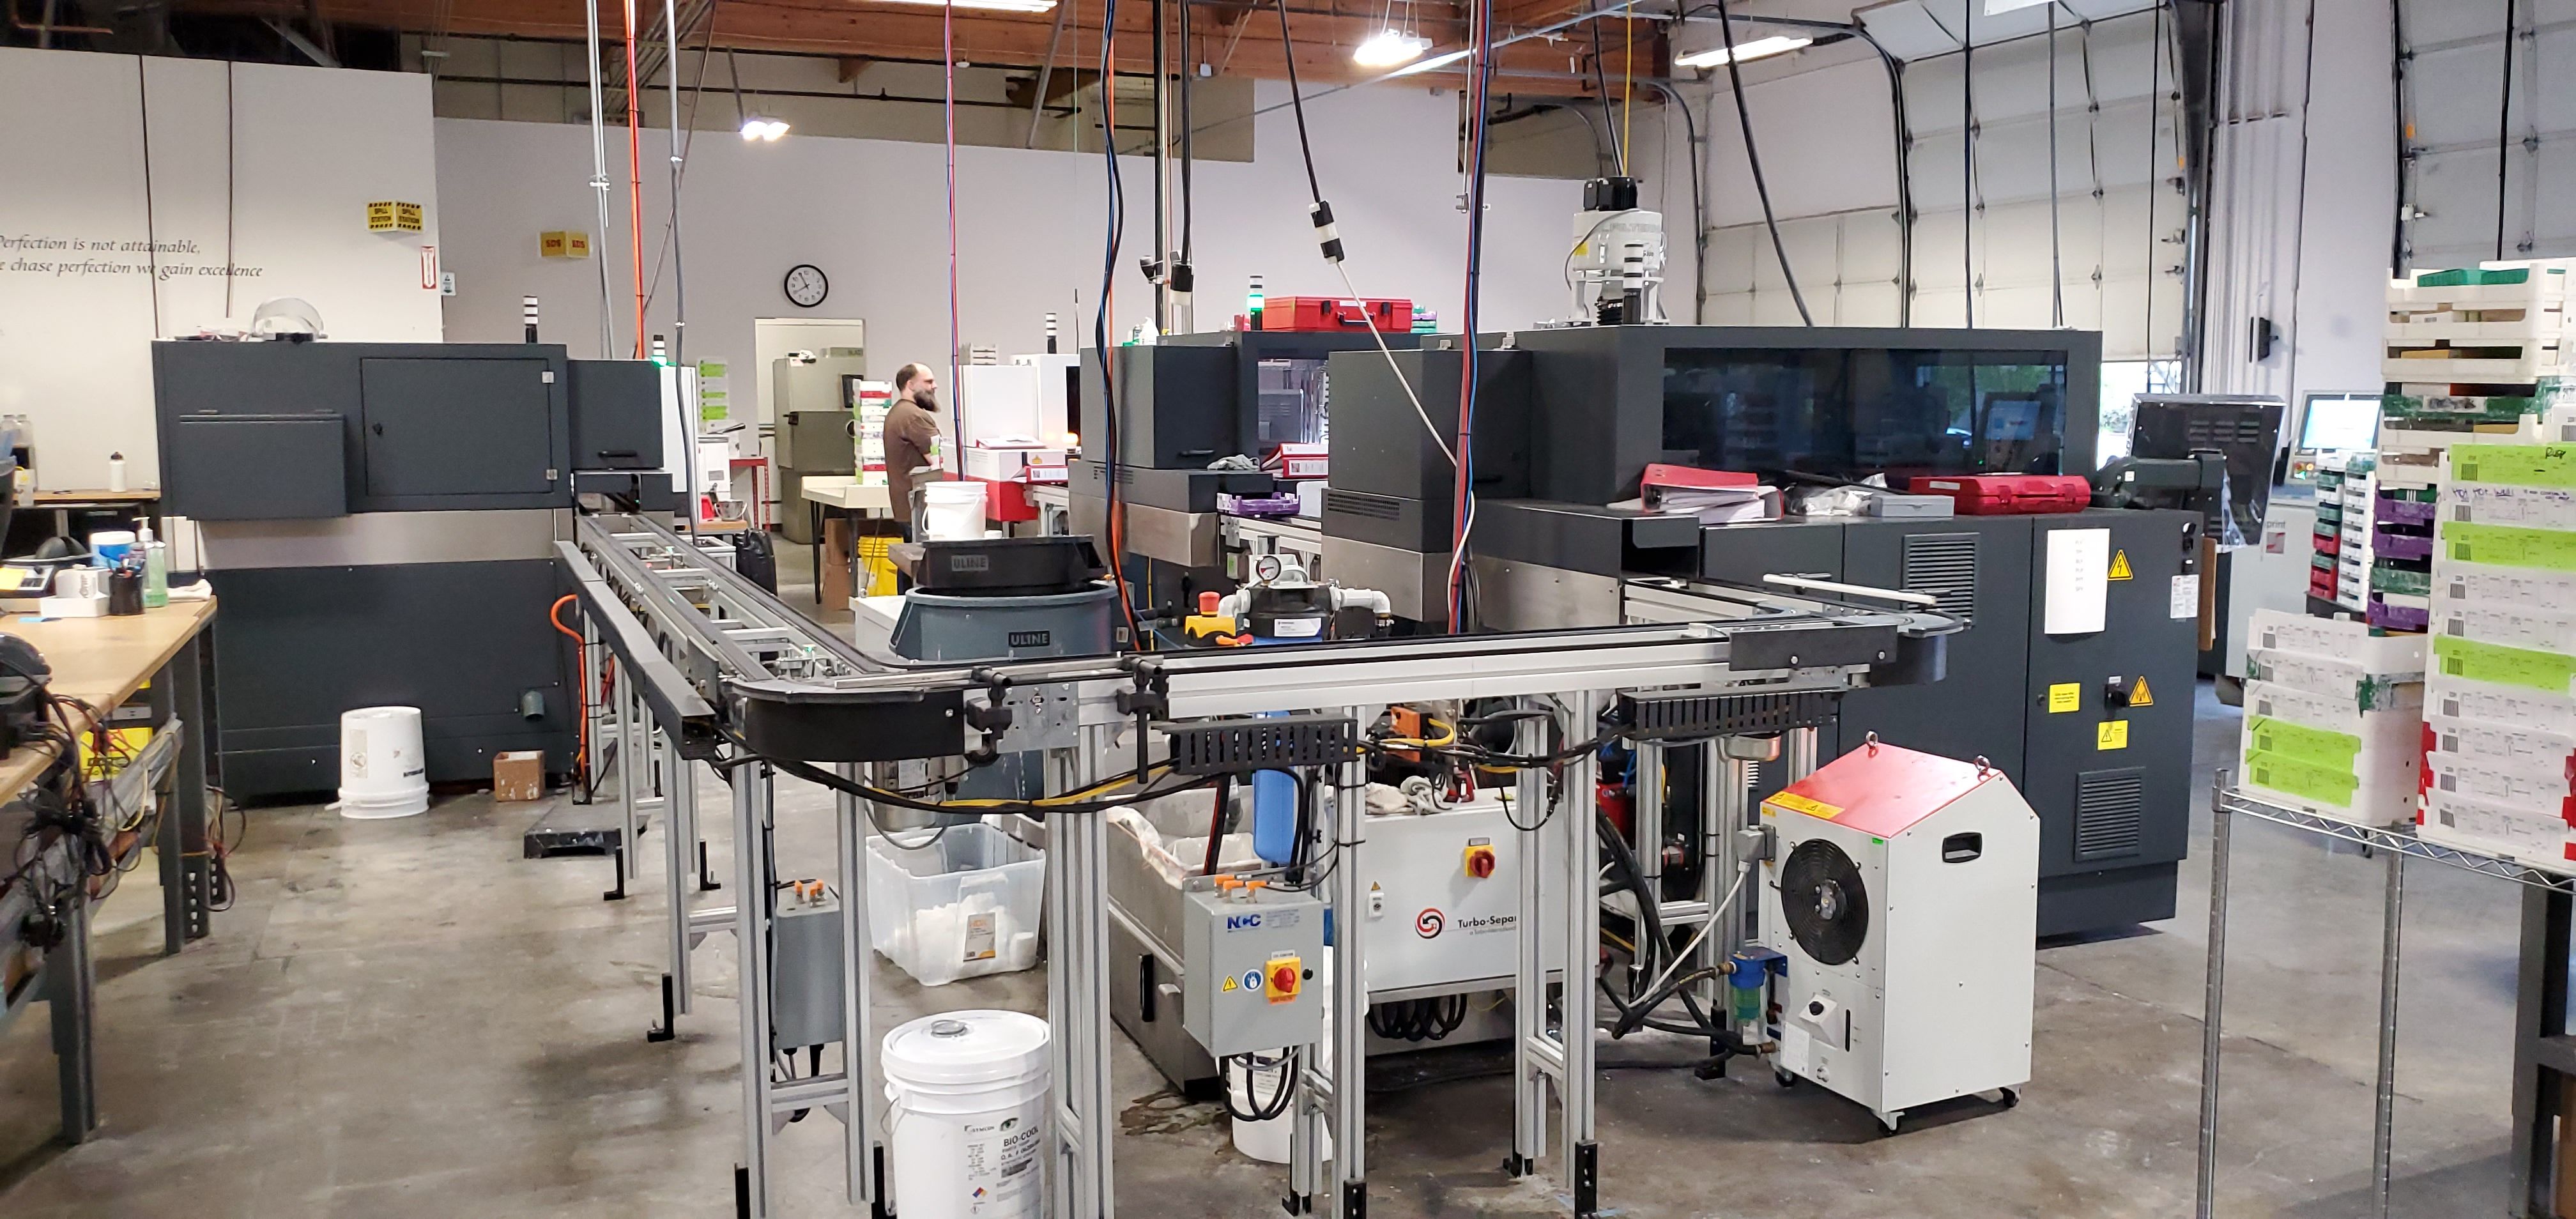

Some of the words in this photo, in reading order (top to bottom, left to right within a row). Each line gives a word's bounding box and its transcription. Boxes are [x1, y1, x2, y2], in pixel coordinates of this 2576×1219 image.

[73, 237, 86, 250] is
[91, 240, 116, 250] not
[120, 240, 201, 254] attainable,
[11, 257, 54, 272] chase
[56, 258, 131, 277] perfection
[159, 263, 194, 281] gain
[953, 557, 986, 569] ULINE
[1011, 633, 1048, 645] ULINE
